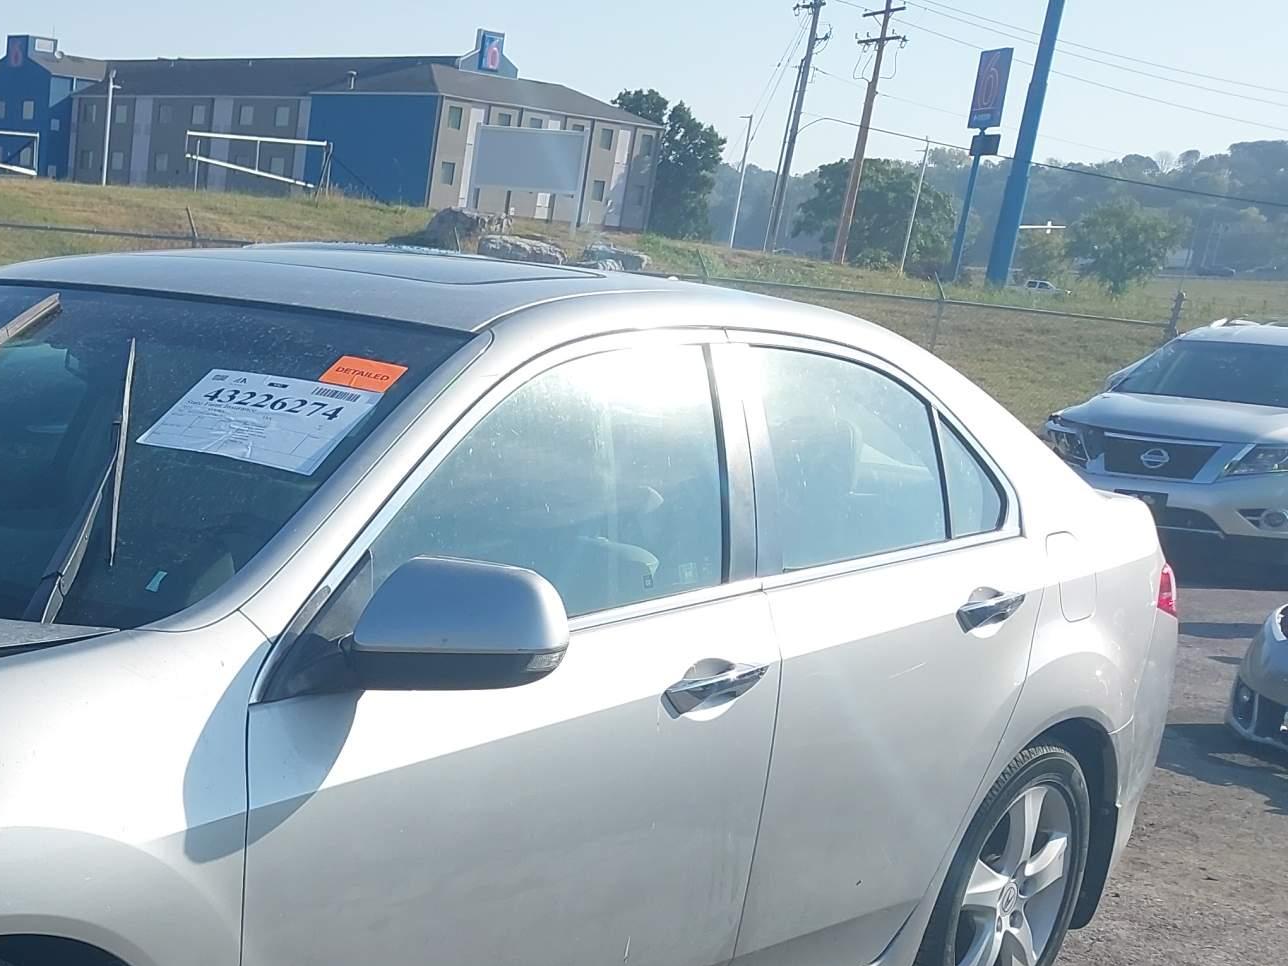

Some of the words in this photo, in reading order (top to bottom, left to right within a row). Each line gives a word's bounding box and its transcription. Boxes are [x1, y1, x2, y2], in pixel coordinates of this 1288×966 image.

[977, 51, 1001, 109] 6
[334, 364, 391, 382] DETAILED
[203, 387, 344, 421] 43226274
